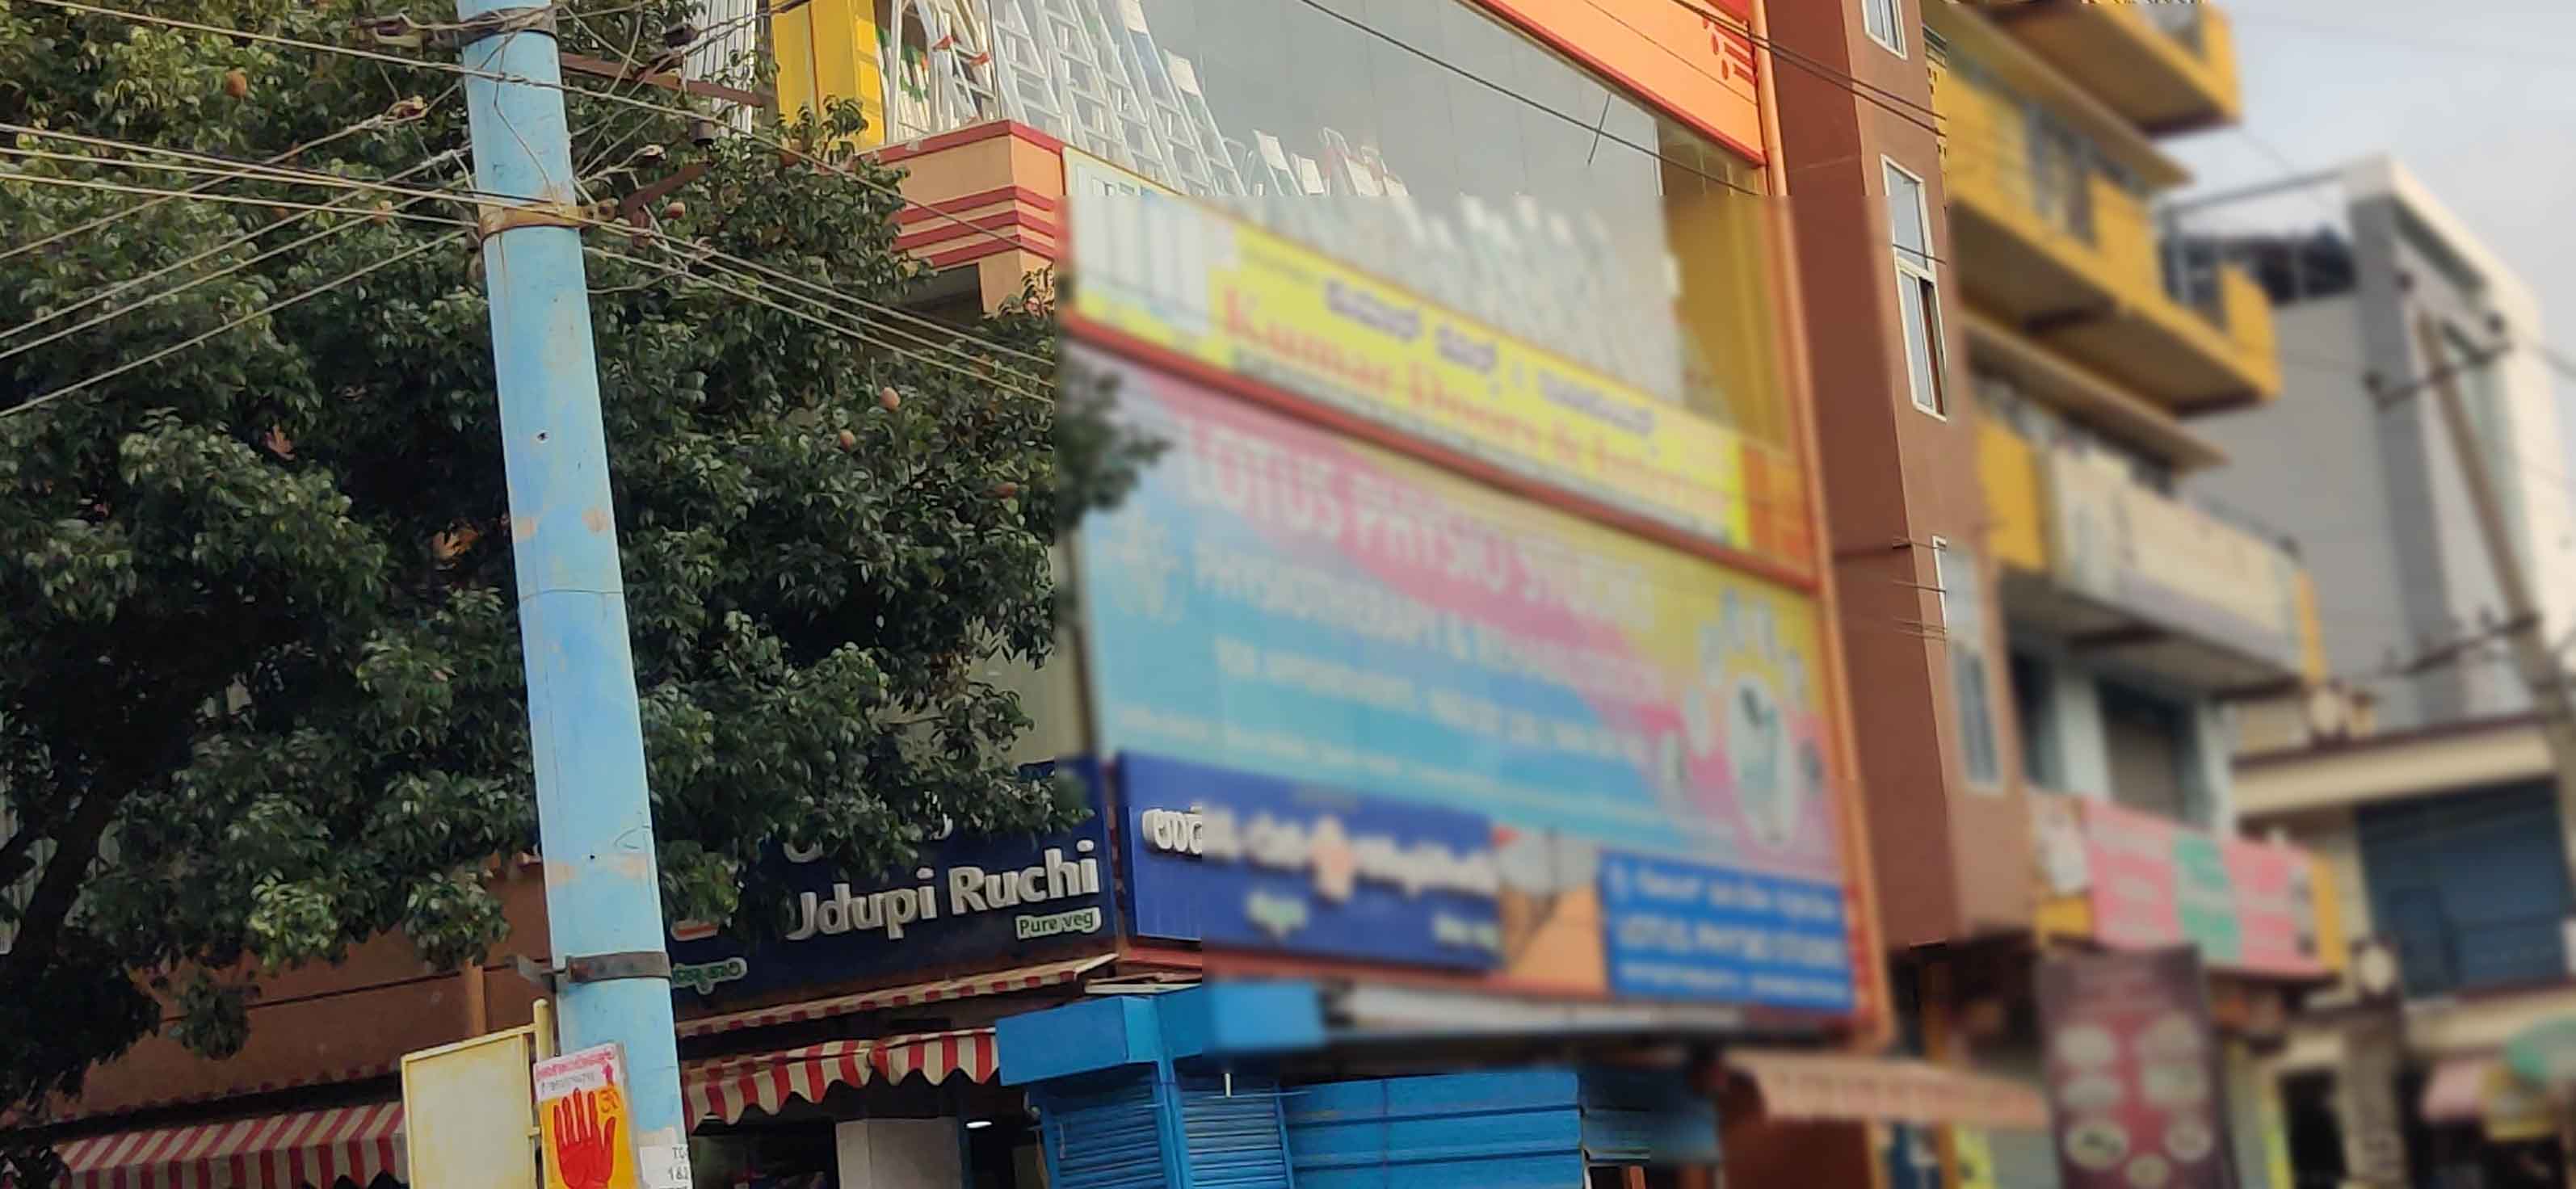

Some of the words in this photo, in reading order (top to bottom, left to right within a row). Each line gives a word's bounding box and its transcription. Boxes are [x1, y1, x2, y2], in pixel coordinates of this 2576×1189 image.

[948, 840, 1100, 916] Ruchi
[1019, 913, 1058, 935] Pure
[1062, 914, 1094, 933] veg
